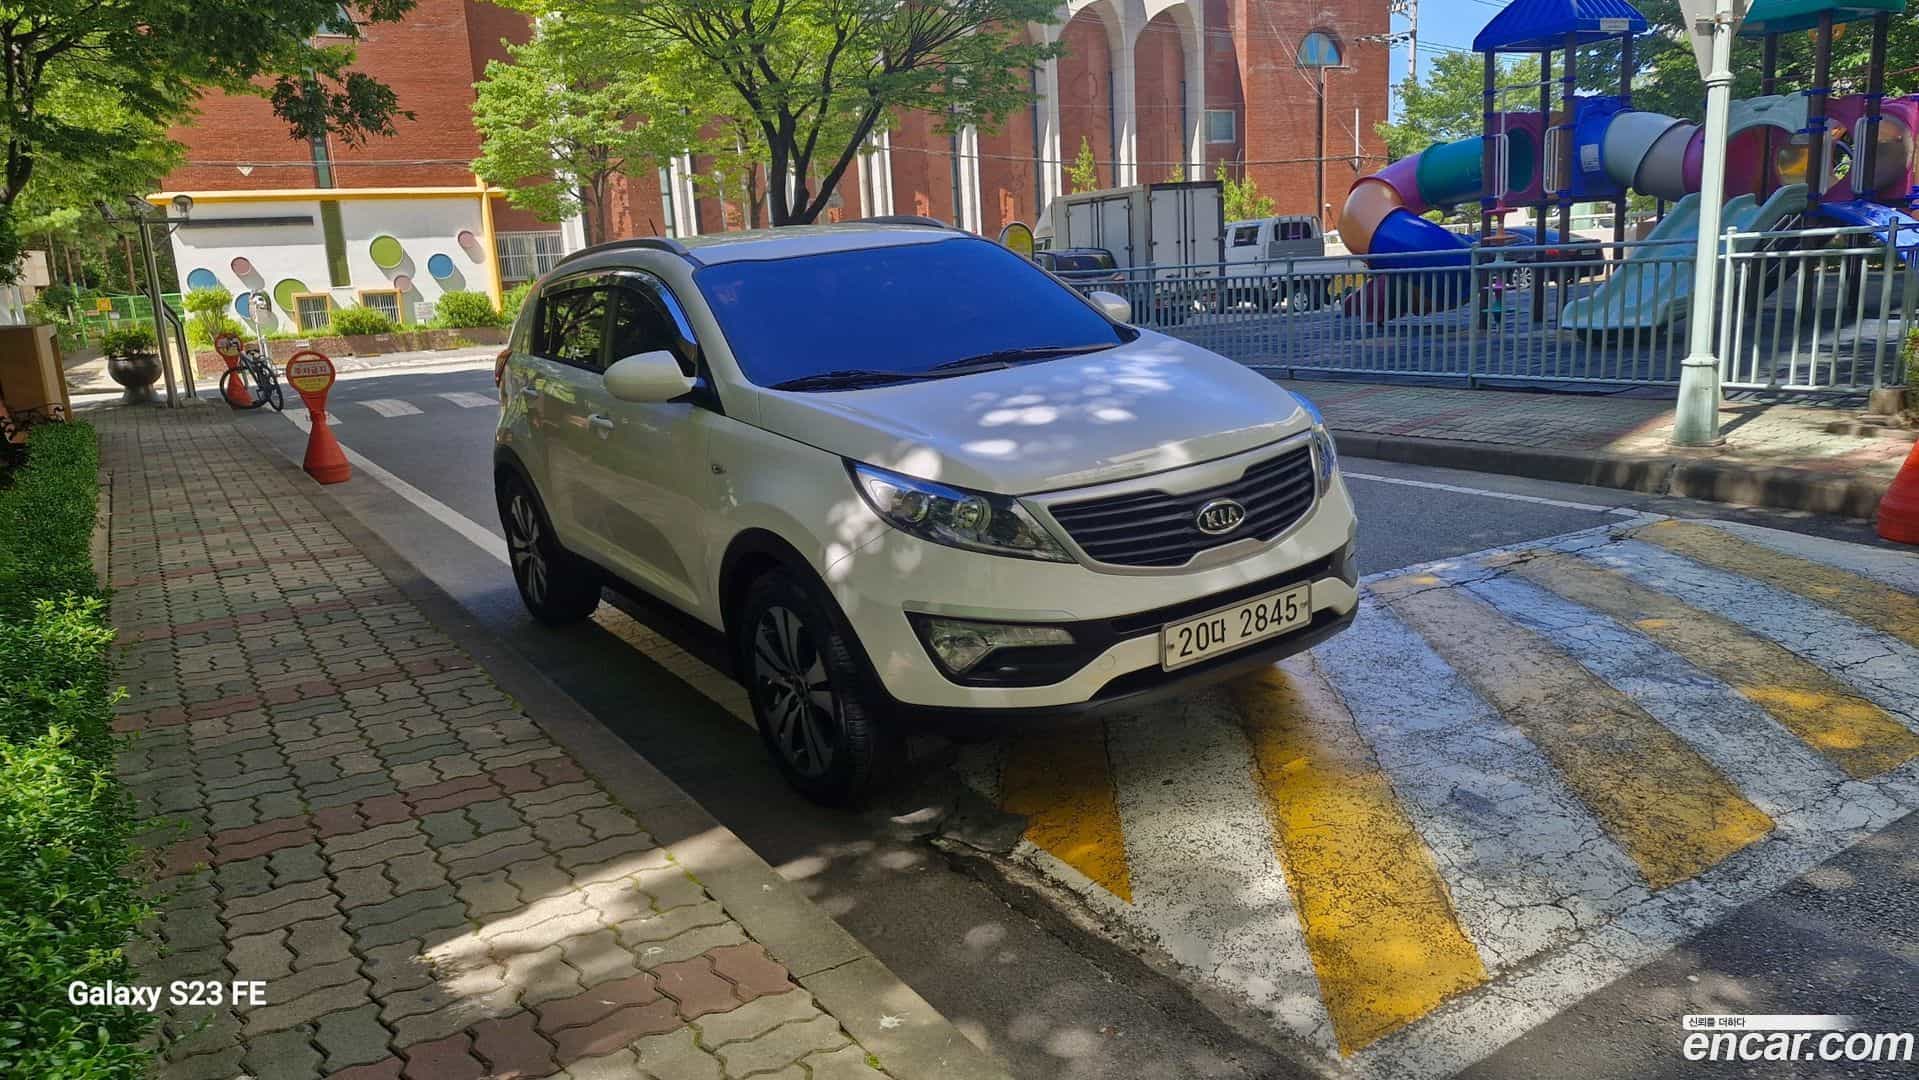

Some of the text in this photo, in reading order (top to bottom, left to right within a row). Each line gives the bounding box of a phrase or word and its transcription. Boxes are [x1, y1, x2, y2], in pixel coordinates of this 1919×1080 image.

[1204, 506, 1240, 529] KIA
[1178, 593, 1298, 657] 20다 2845
